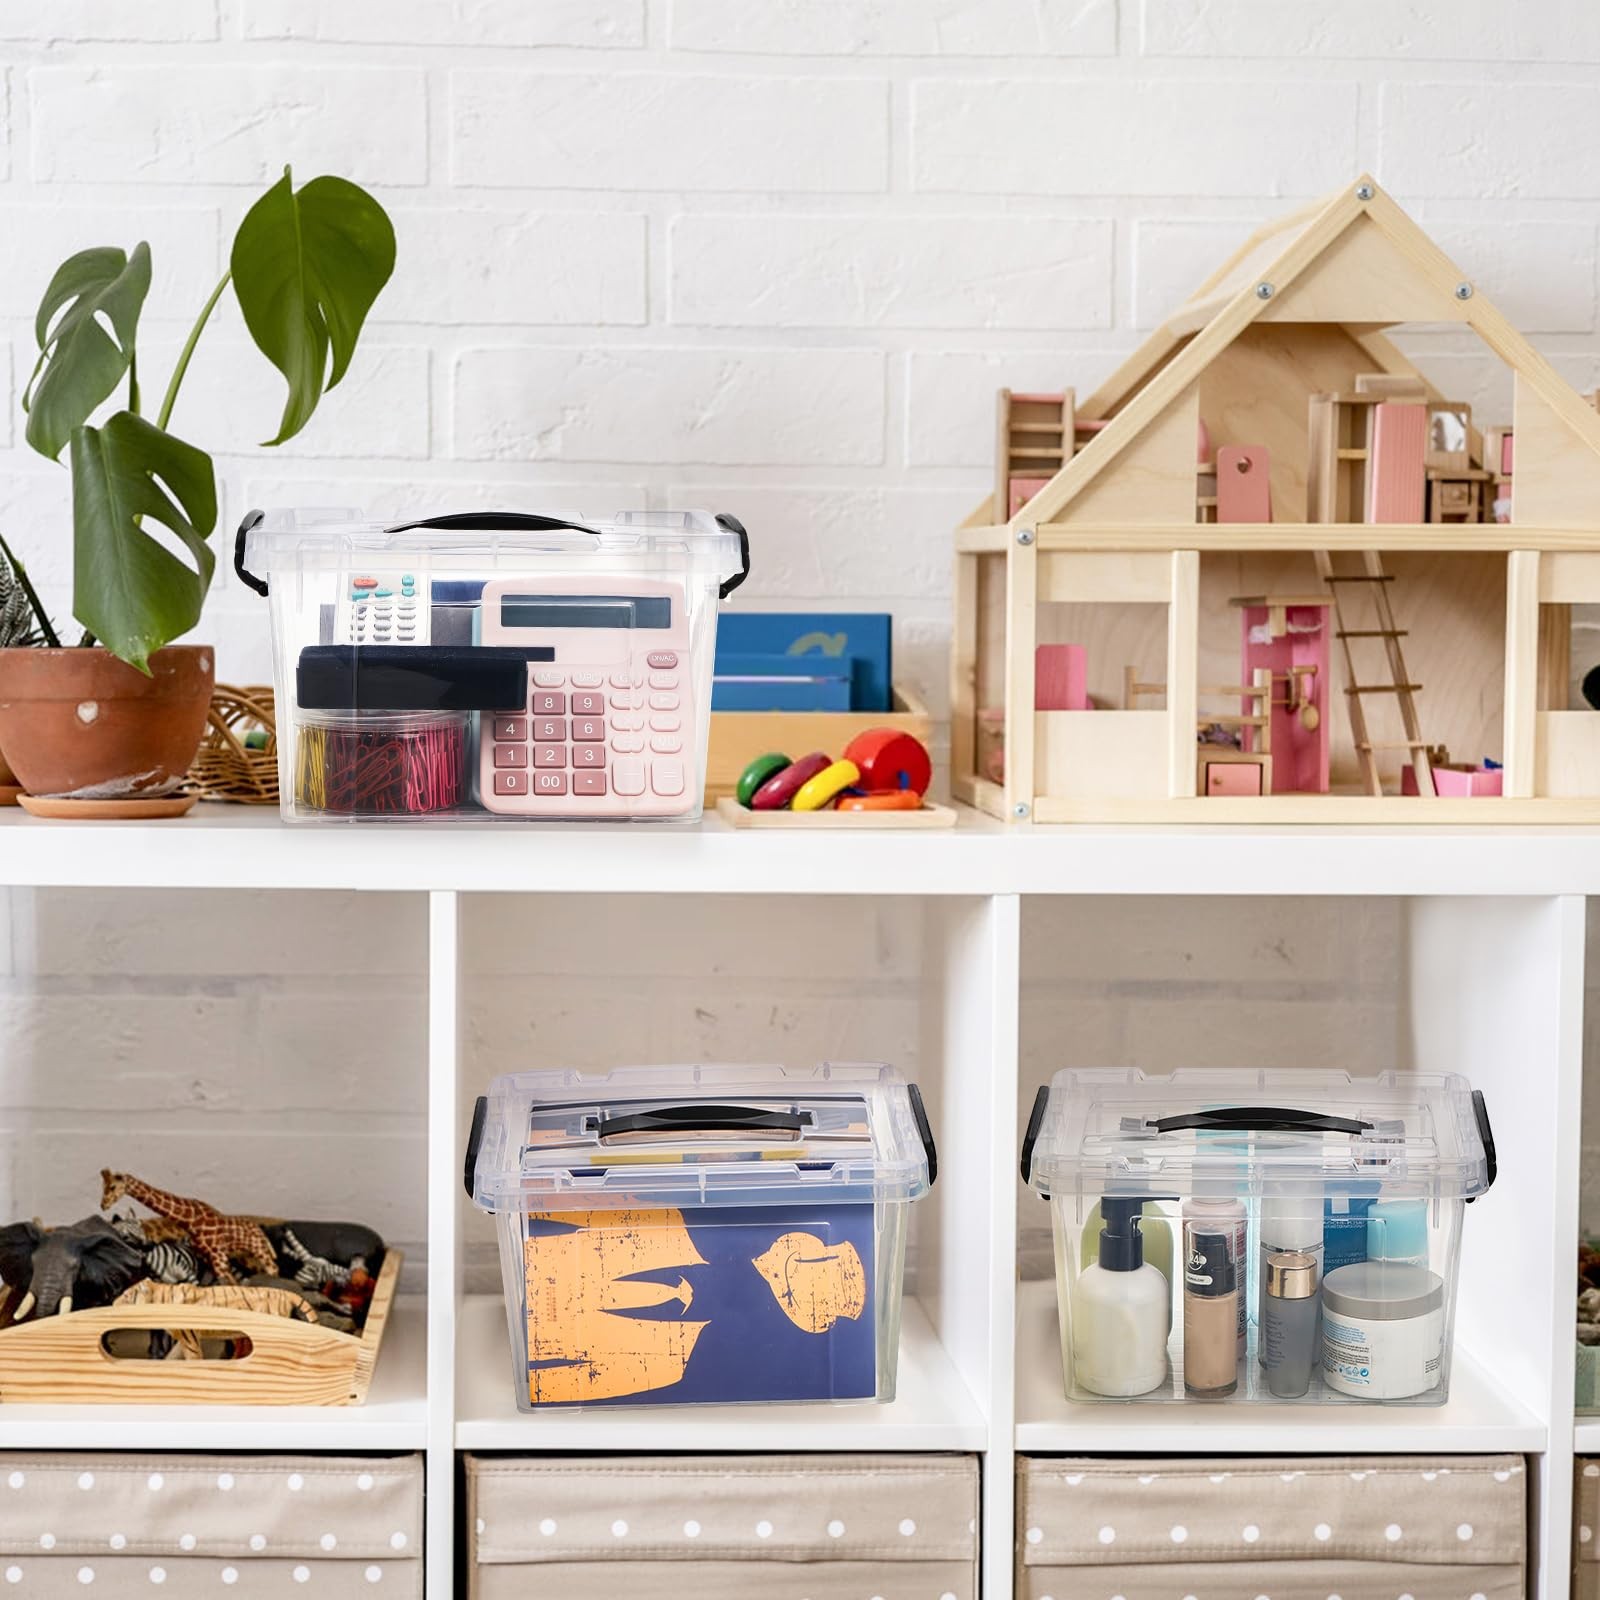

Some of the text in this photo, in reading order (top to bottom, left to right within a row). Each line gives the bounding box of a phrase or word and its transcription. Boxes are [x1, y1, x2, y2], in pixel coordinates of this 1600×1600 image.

[544, 697, 593, 709] 8 9
[505, 723, 593, 735] 4 5 6
[507, 749, 594, 761] 1 2 3
[506, 775, 560, 787] 0 00
